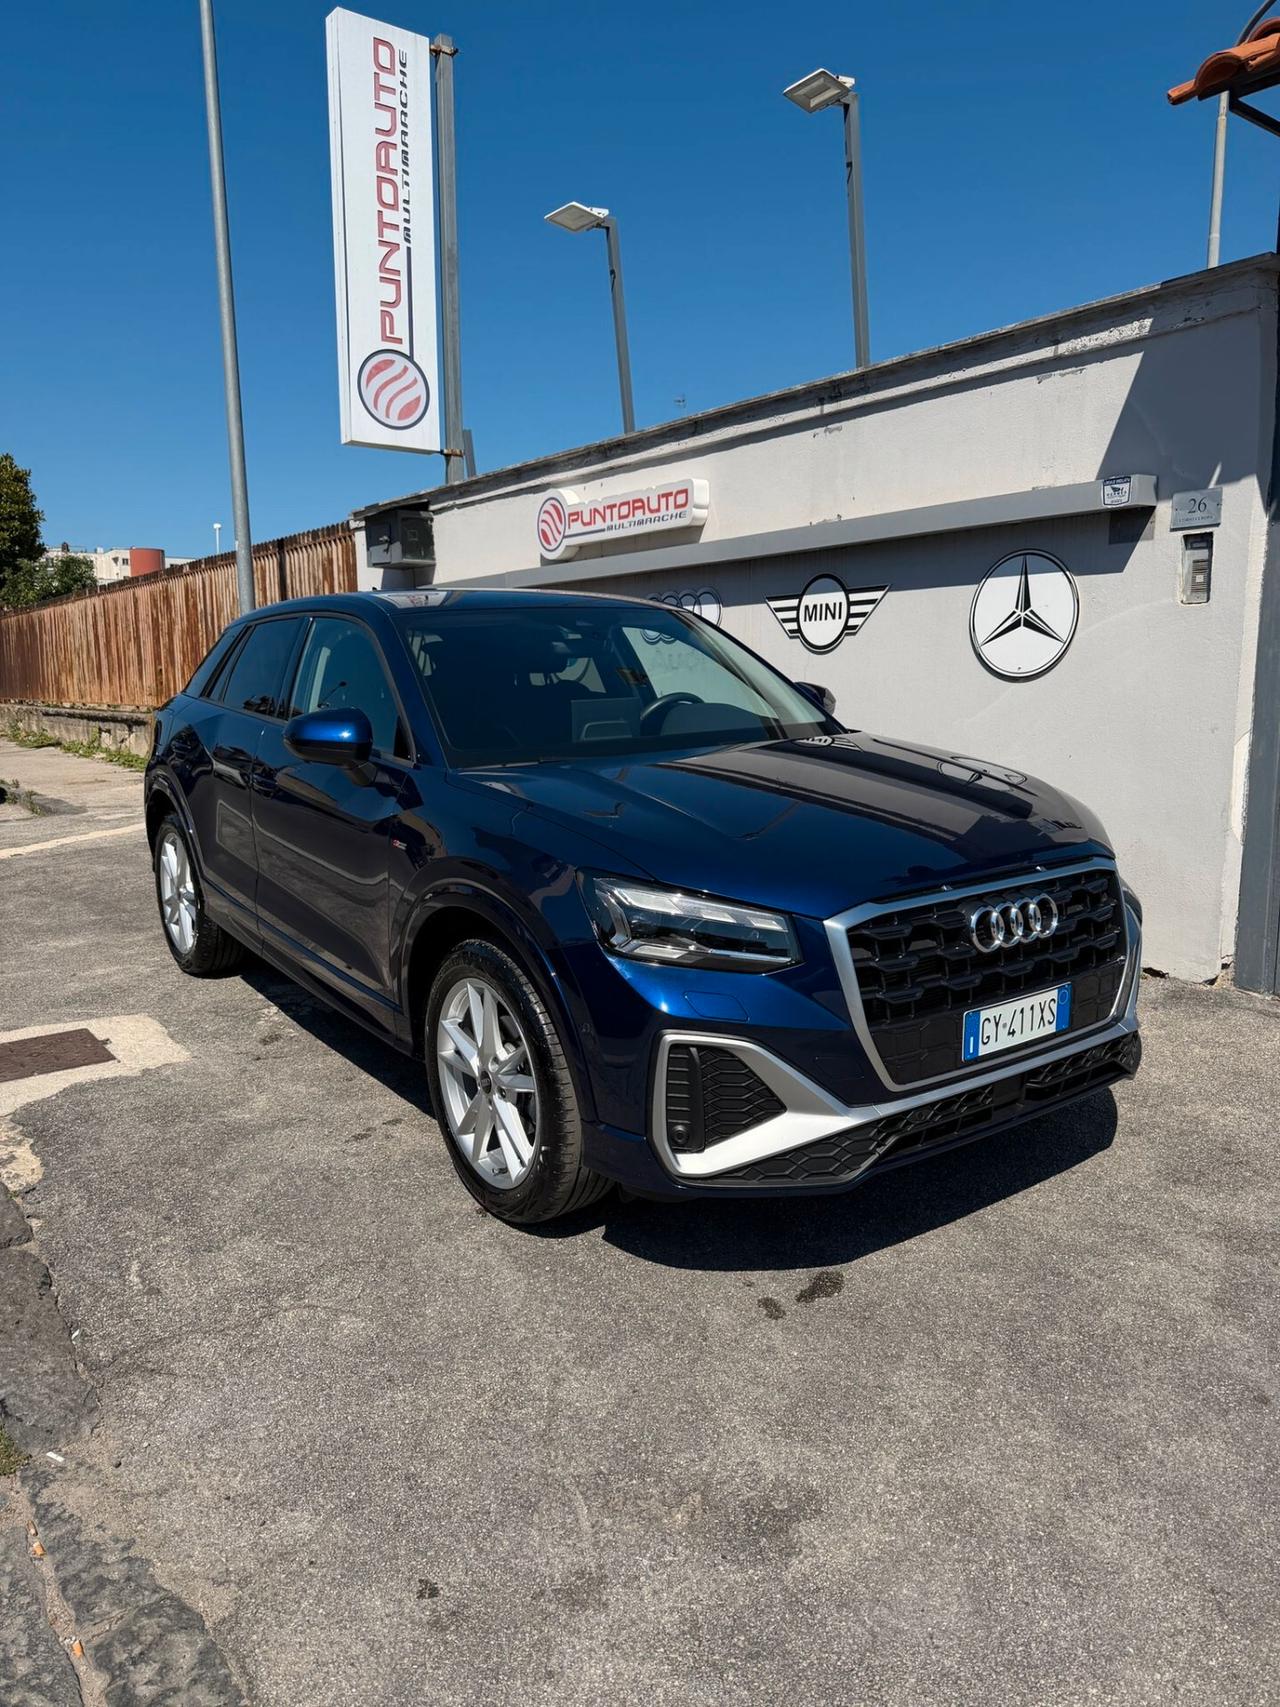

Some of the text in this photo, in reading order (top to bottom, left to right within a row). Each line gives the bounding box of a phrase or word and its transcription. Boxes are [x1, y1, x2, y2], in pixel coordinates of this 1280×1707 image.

[398, 49, 412, 244] MULTIMARCHE
[373, 36, 403, 345] PUNTOAUTO
[567, 488, 689, 530] PUNTOAUTO
[1187, 496, 1207, 514] 26
[605, 511, 688, 532] MULTIMARCHE
[803, 601, 843, 622] MINI
